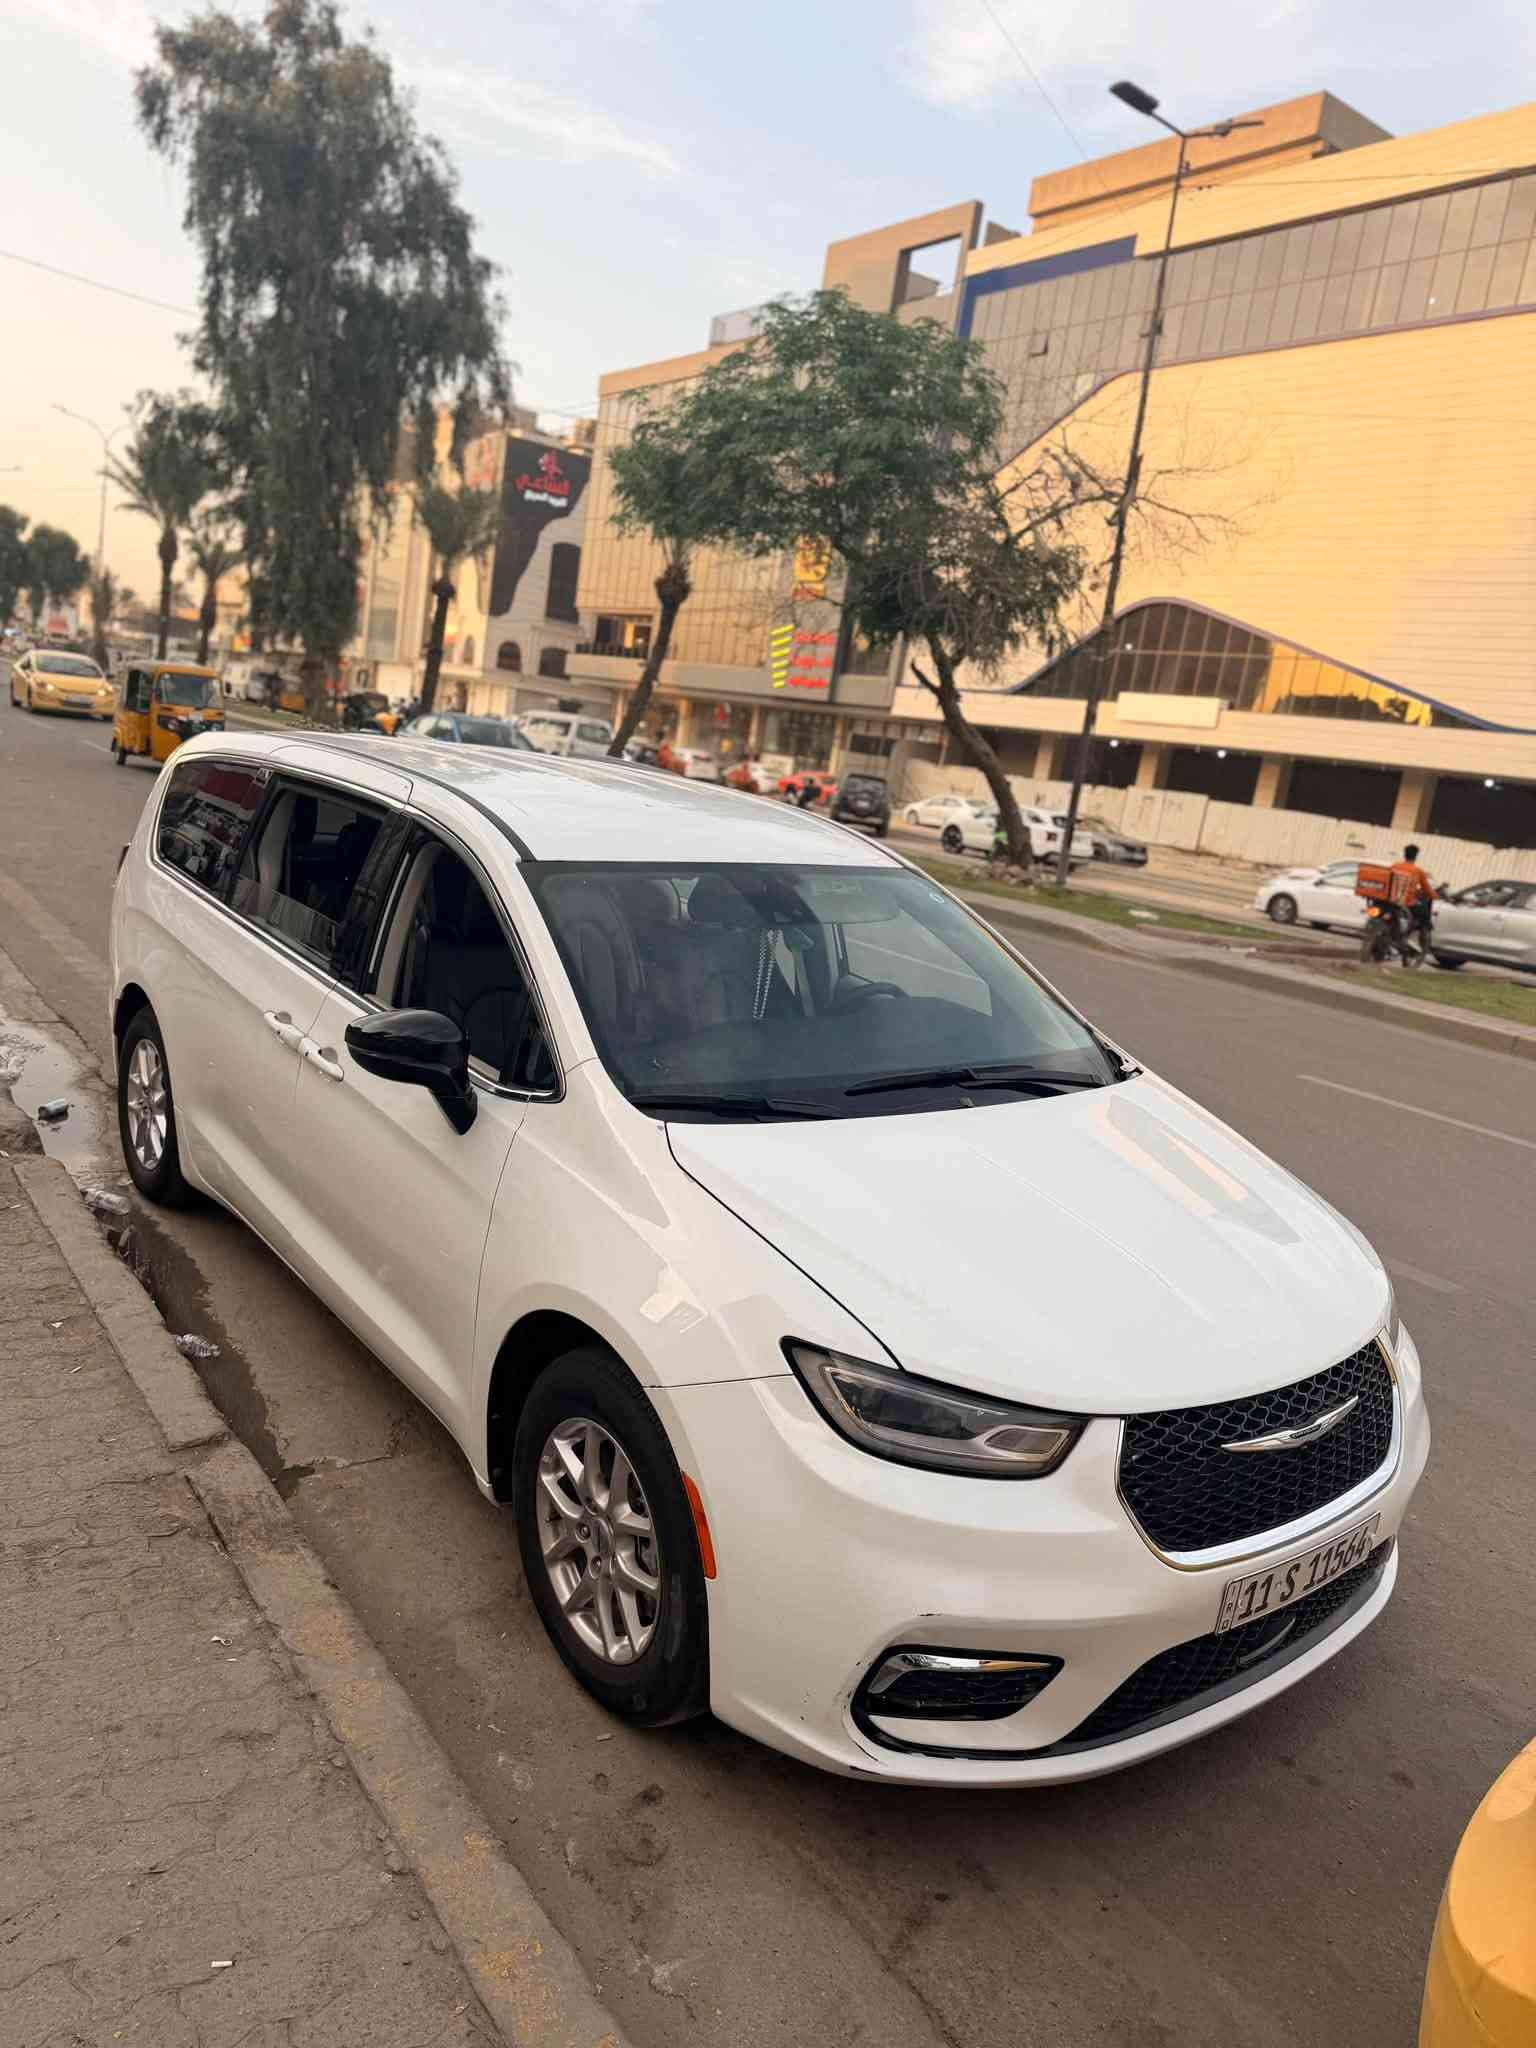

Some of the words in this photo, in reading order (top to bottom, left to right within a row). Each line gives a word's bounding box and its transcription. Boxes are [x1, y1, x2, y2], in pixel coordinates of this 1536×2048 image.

[1238, 1573, 1274, 1621] 11
[1281, 1563, 1300, 1602] S
[1302, 1526, 1368, 1591] 11564
